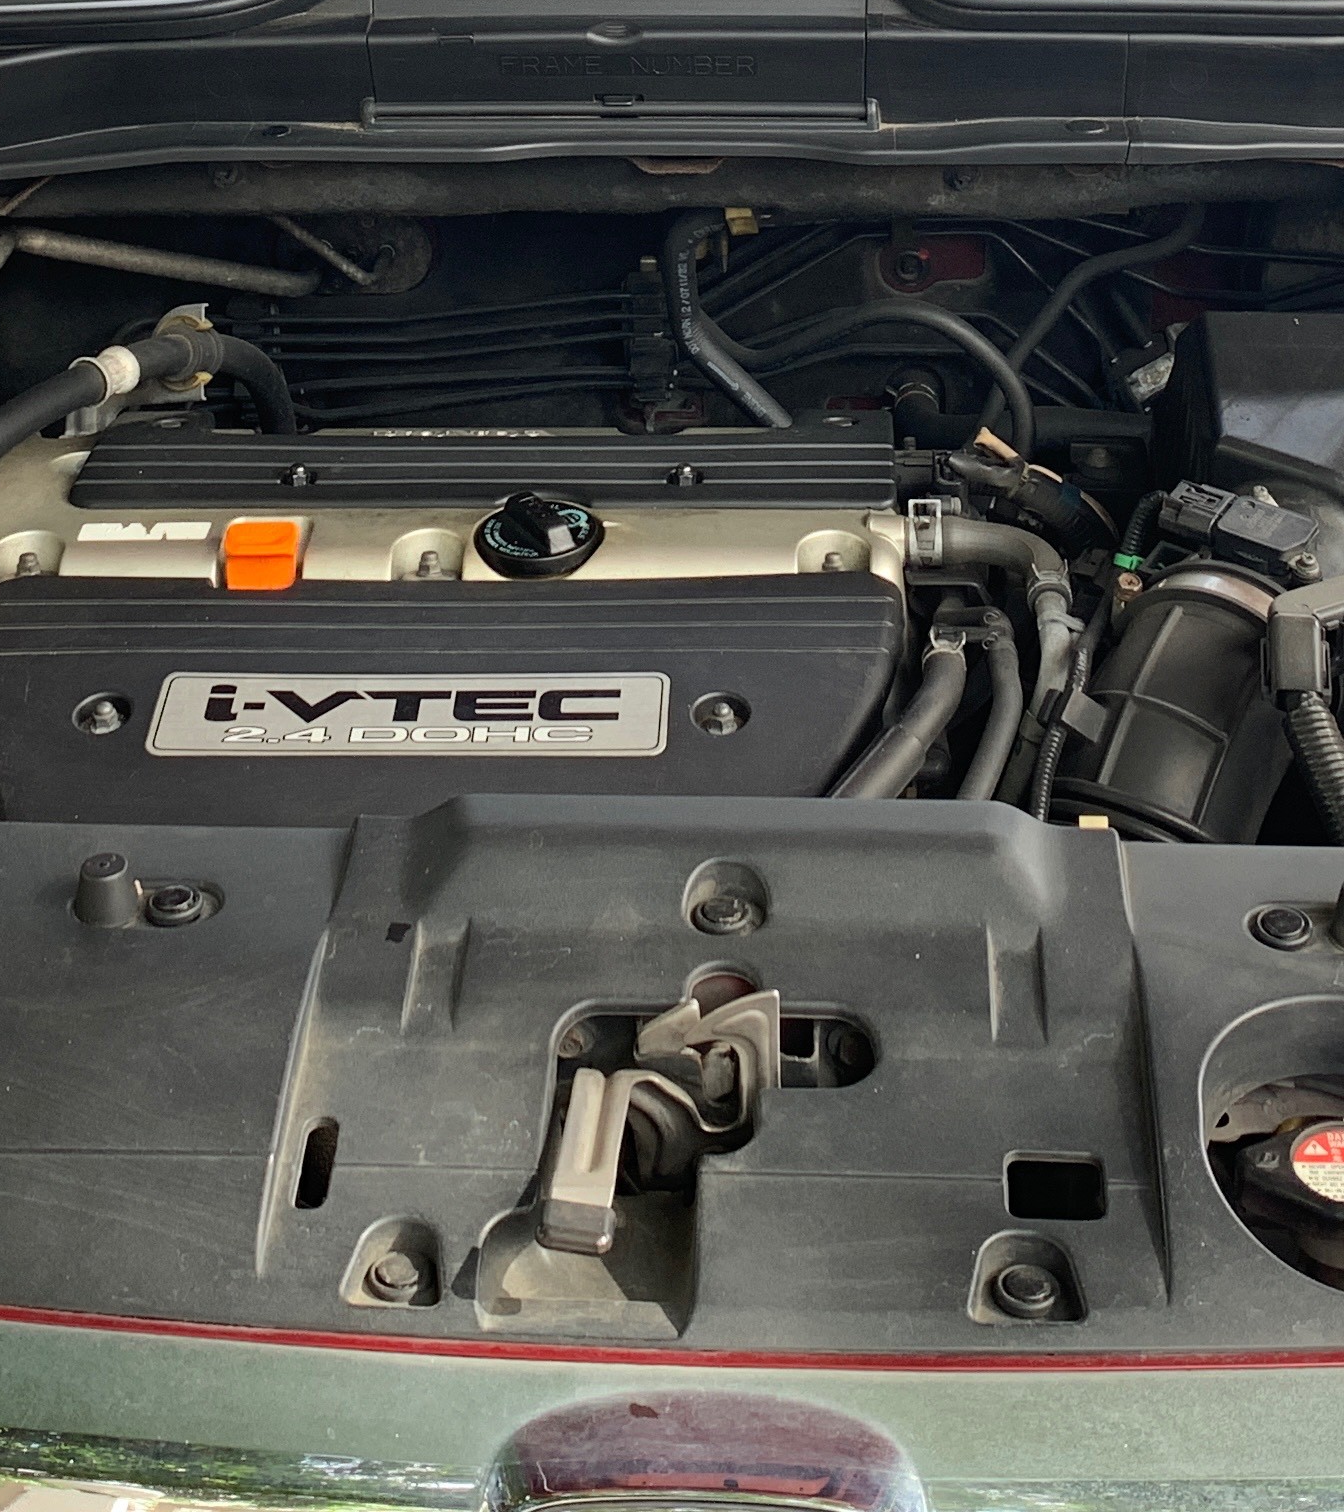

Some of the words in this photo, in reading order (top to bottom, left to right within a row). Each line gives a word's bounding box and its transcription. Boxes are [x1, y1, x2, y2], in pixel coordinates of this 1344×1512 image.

[500, 55, 604, 75] FRAME
[629, 55, 755, 75] NUMBER
[203, 684, 622, 724] i-VTEC
[222, 725, 332, 744] 2.4
[347, 725, 594, 744] DOHC
